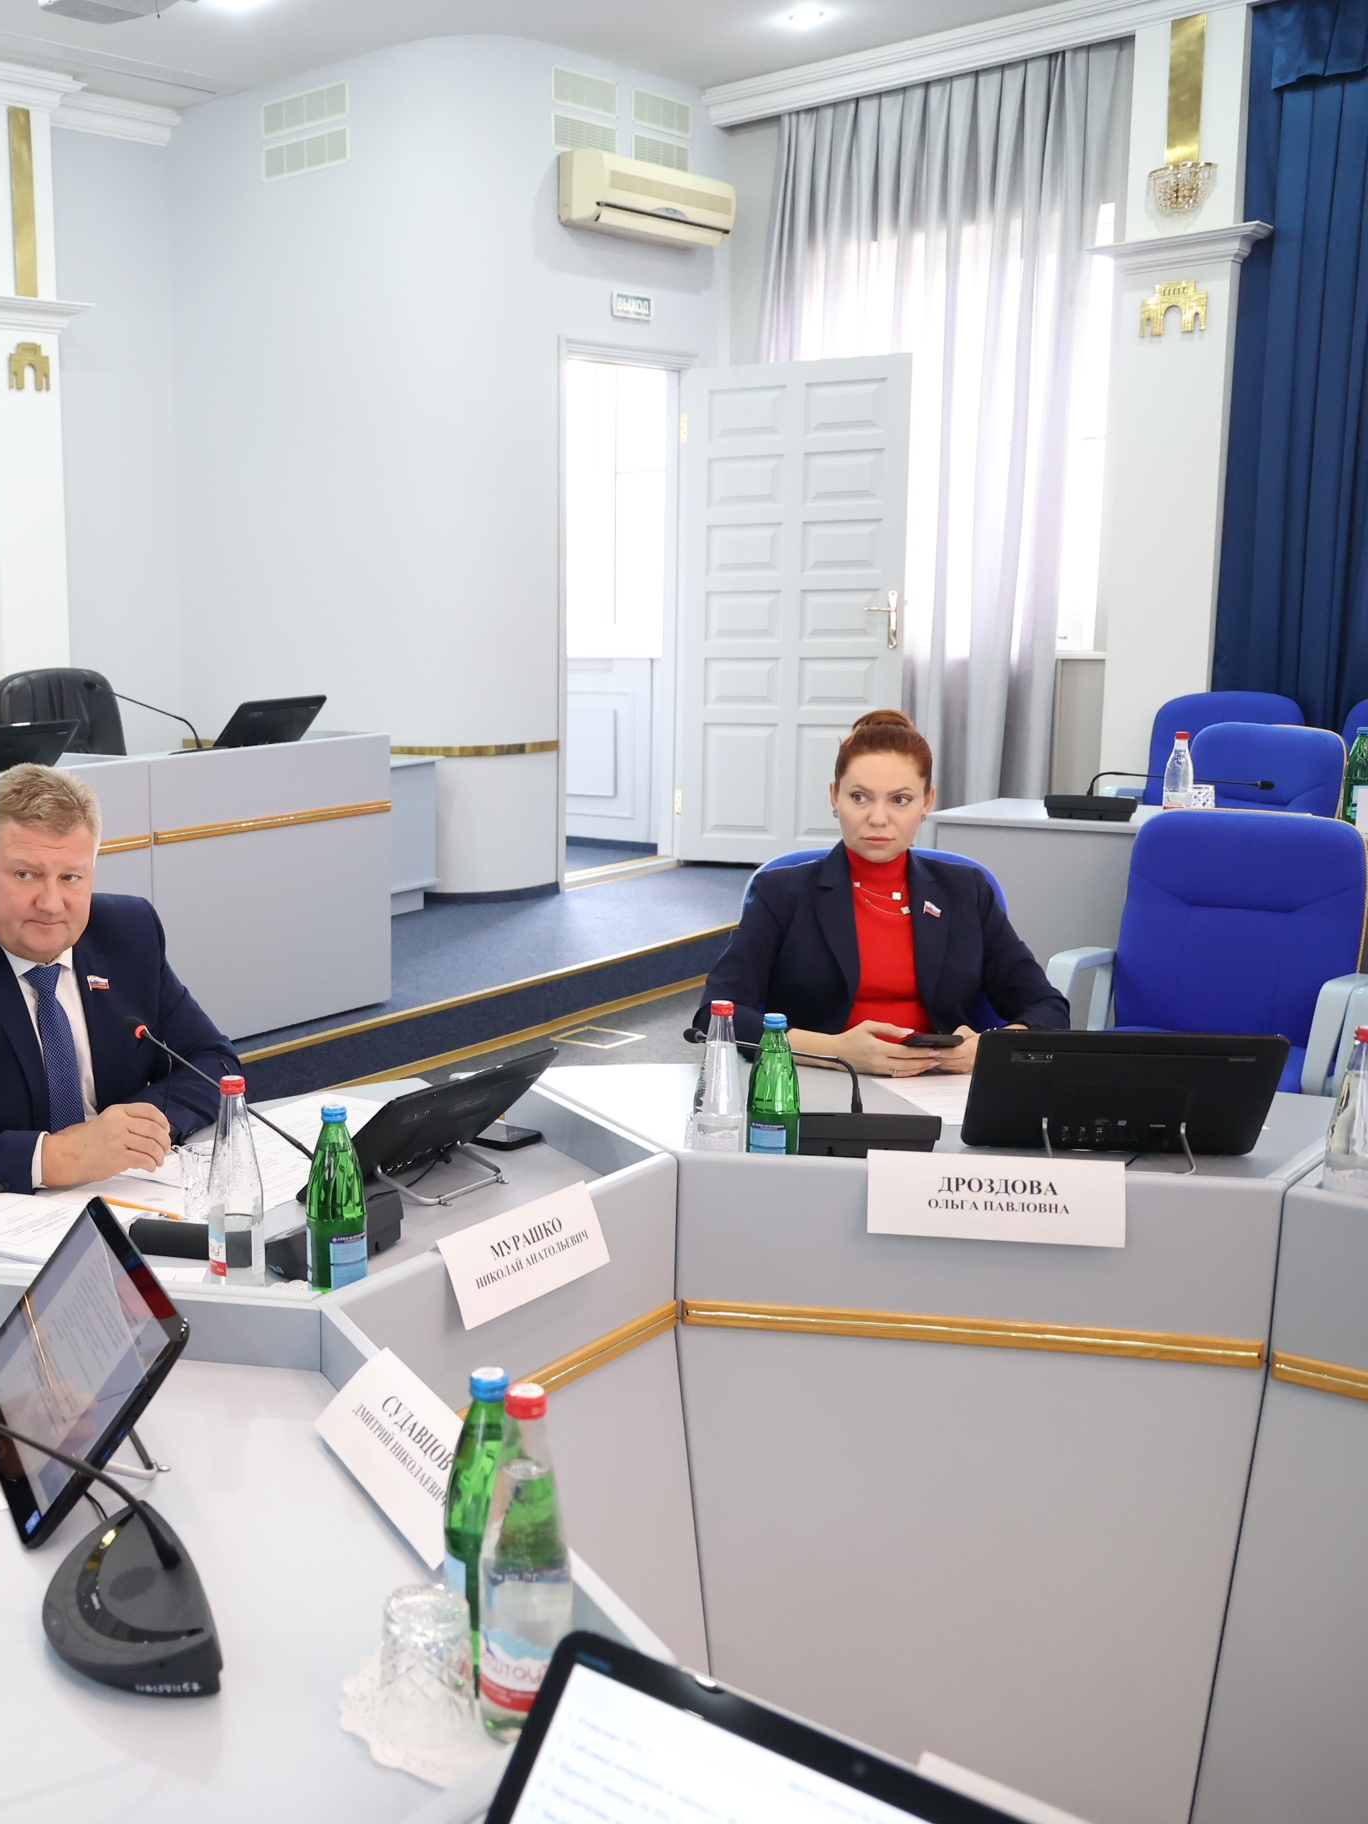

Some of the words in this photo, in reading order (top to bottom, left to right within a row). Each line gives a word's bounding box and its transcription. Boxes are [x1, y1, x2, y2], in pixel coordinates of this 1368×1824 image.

[617, 296, 650, 315] ВЫХОД
[927, 1198, 979, 1211] ОЛЬГА
[983, 1200, 1070, 1214] ПАВЛОВНА
[937, 1176, 1059, 1196] ДРОЗДОВА
[475, 1258, 524, 1290] НИКОЛАЙ
[525, 1229, 590, 1268] АНАТОЛЬЕВИЧ
[489, 1217, 563, 1261] МУРАШКО
[351, 1402, 396, 1448] ДМИТРИЙ
[381, 1395, 454, 1471] СУДАВЦОВ
